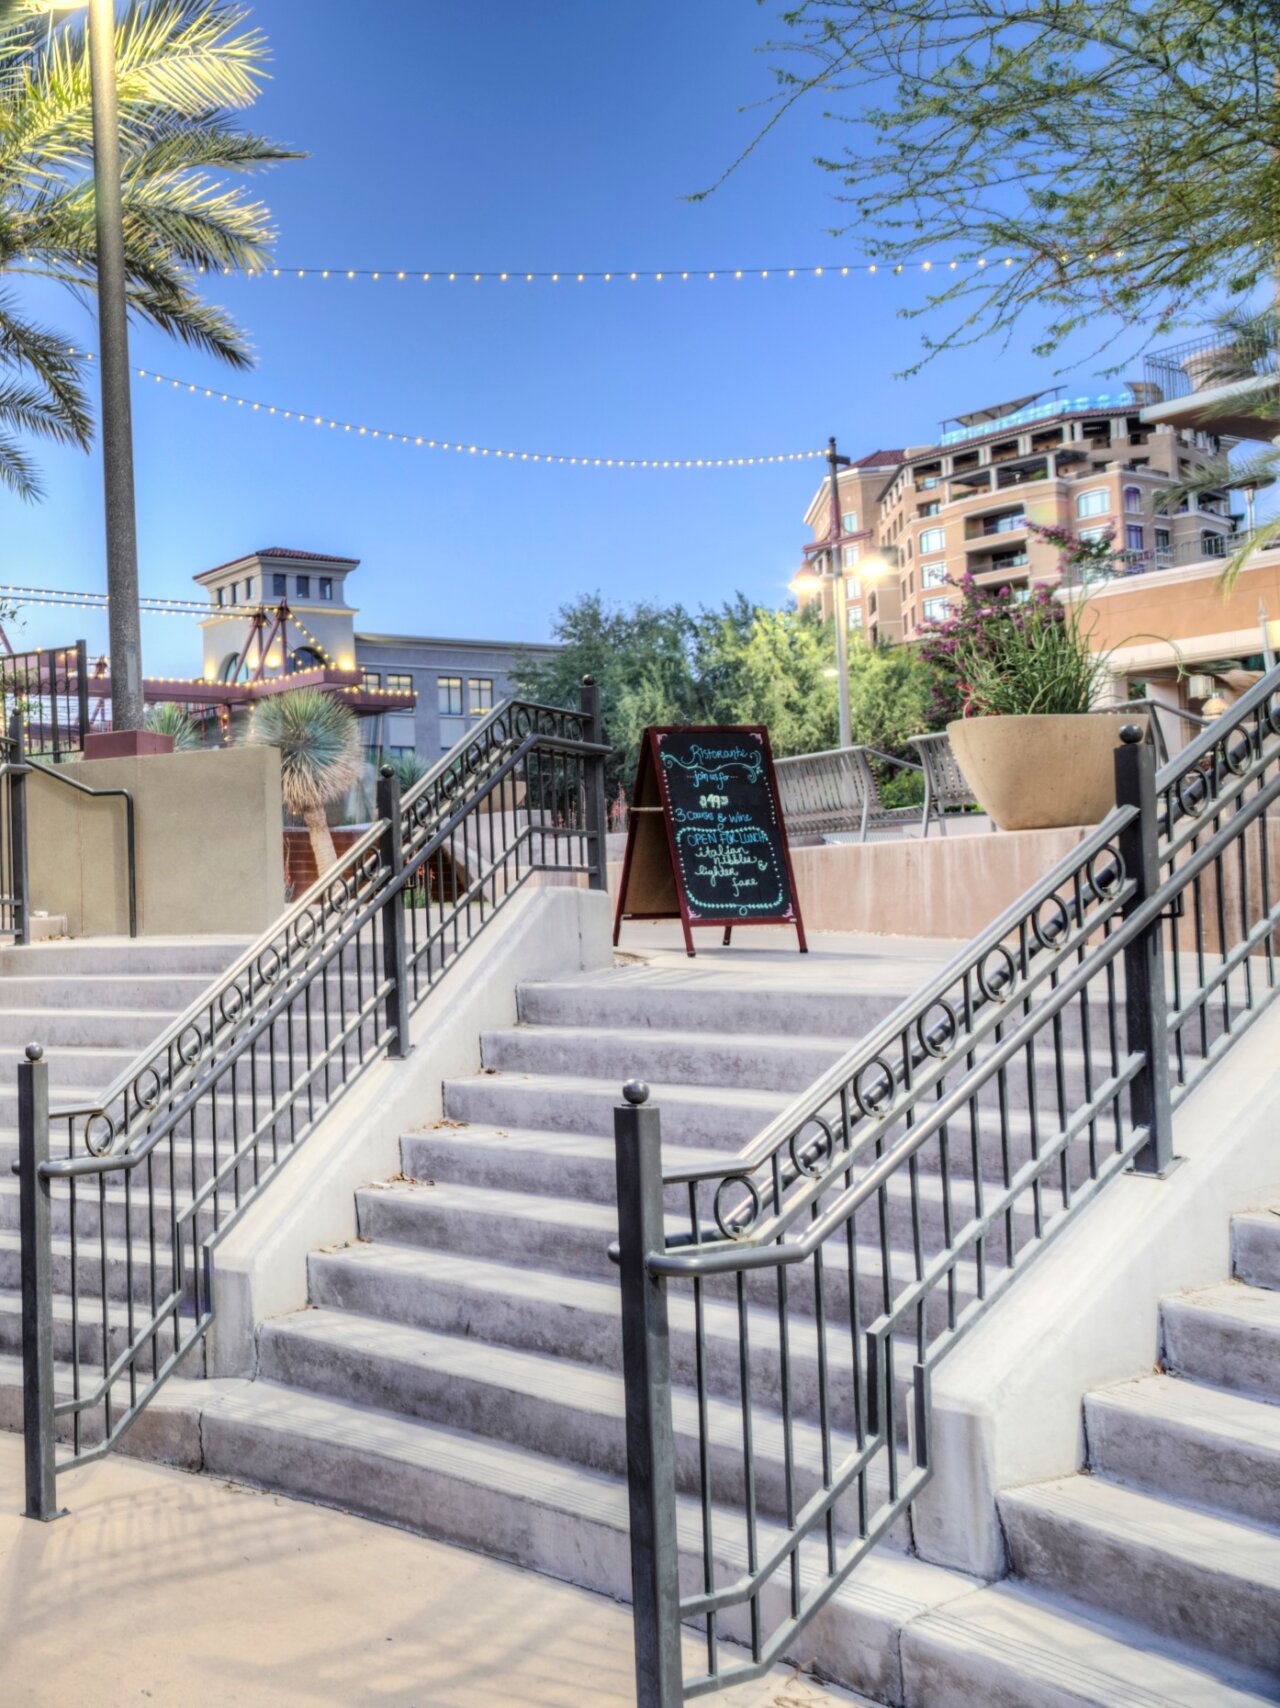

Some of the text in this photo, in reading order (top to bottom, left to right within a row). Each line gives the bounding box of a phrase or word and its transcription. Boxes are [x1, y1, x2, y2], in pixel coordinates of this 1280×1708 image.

[693, 770, 730, 791] join us for
[675, 808, 687, 822] 3
[717, 812, 728, 823] &
[687, 832, 717, 846] OPEN
[720, 832, 739, 845] FOR
[694, 844, 750, 858] italian
[713, 854, 768, 871] nibbles &
[694, 865, 739, 887] lighter
[732, 877, 758, 897] fare
